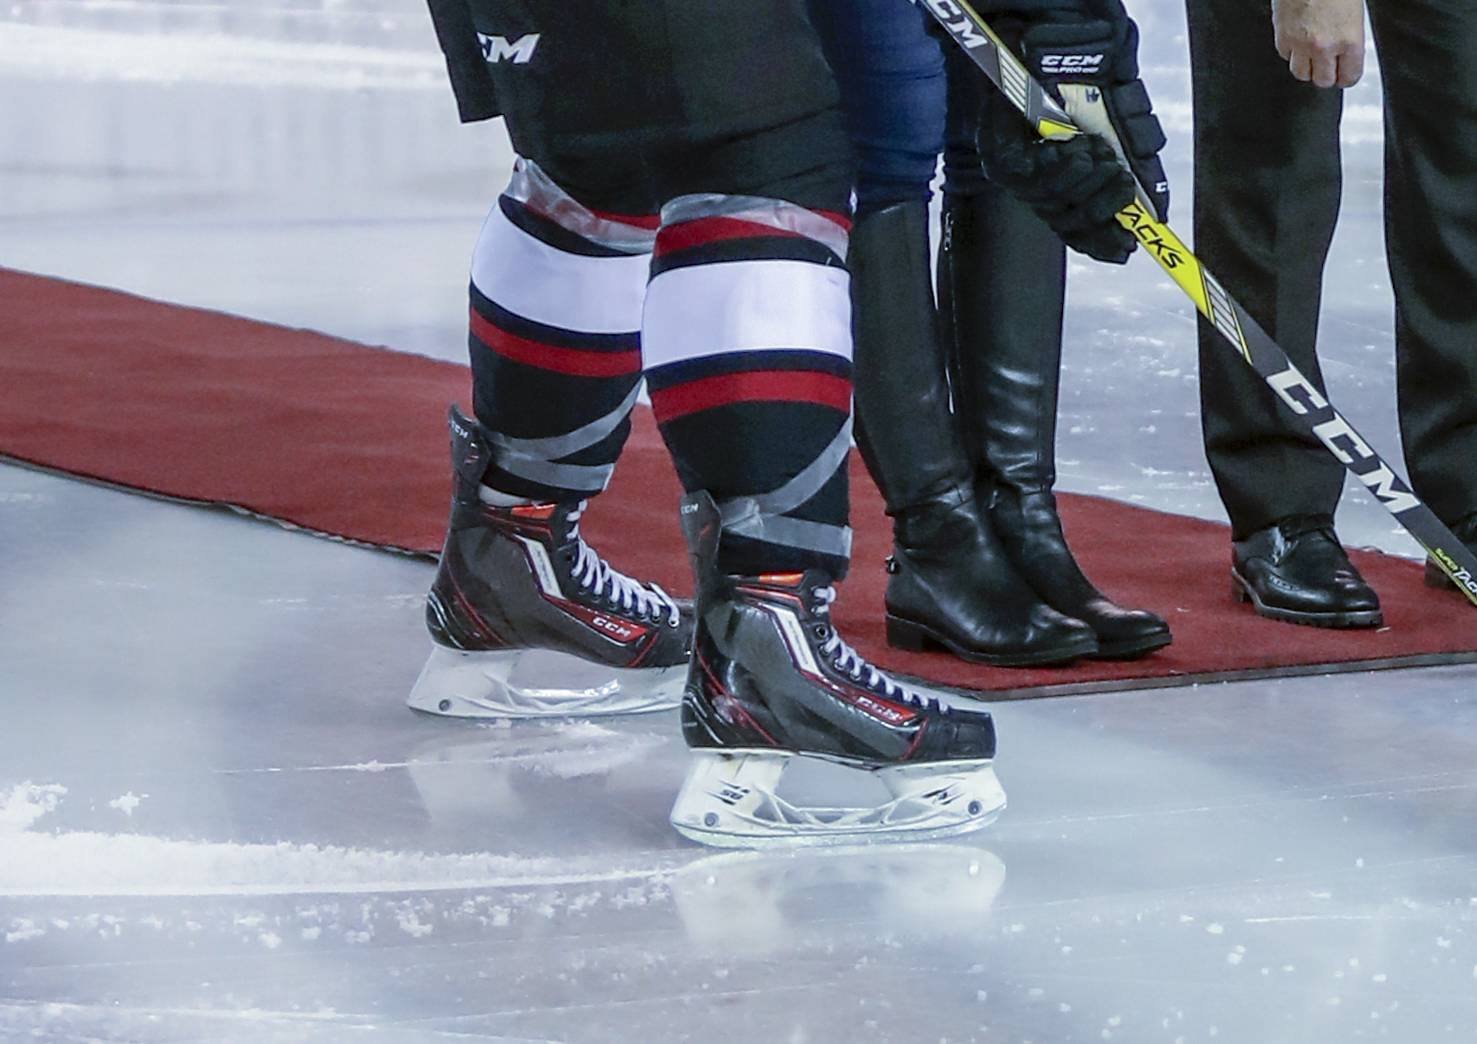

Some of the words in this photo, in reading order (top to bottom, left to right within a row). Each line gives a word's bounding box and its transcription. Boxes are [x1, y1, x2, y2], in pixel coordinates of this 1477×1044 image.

[1041, 54, 1104, 66] CCM
[1266, 358, 1422, 514] CCM
[592, 617, 632, 638] CCM
